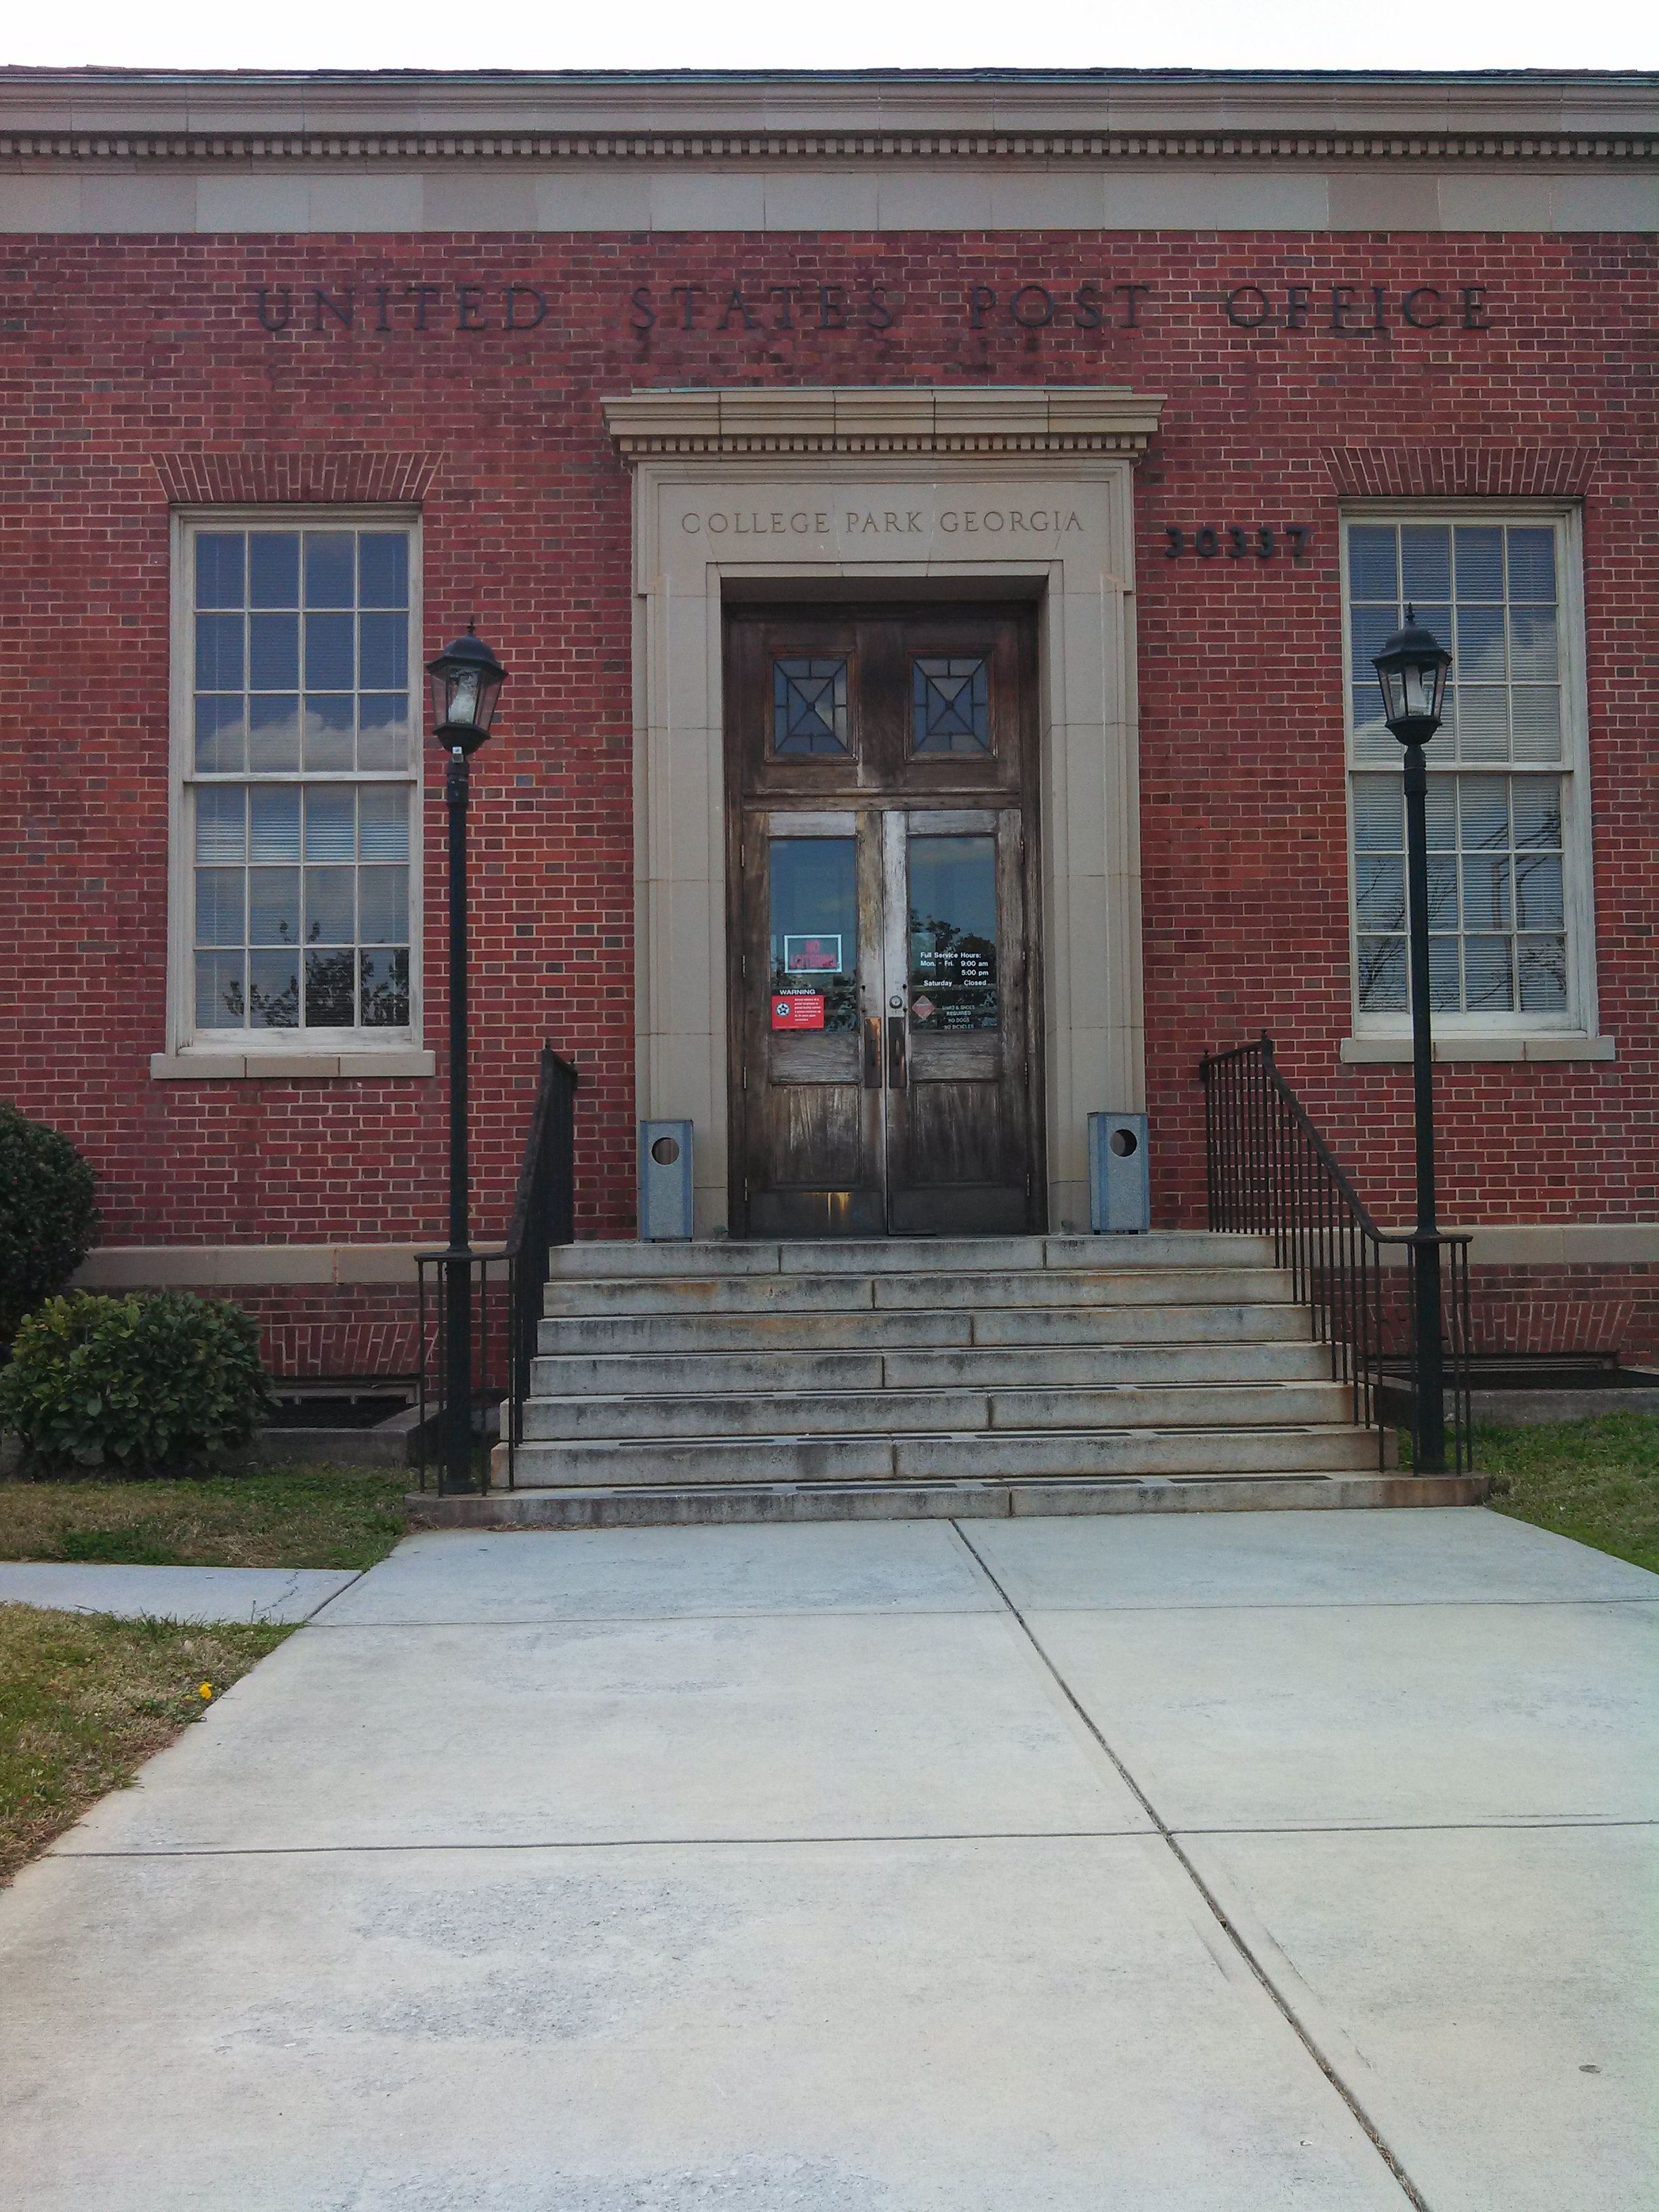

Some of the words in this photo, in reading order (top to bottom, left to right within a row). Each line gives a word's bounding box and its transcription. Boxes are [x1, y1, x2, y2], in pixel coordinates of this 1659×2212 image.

[256, 285, 548, 331] UNITED
[630, 285, 894, 331] STATES
[970, 283, 1150, 329] POST
[1226, 285, 1491, 330] OFFICE
[682, 512, 830, 534] COLLEGE
[846, 511, 923, 533] PARK
[939, 510, 1084, 533] GEORGIA
[1164, 524, 1311, 558] 30337
